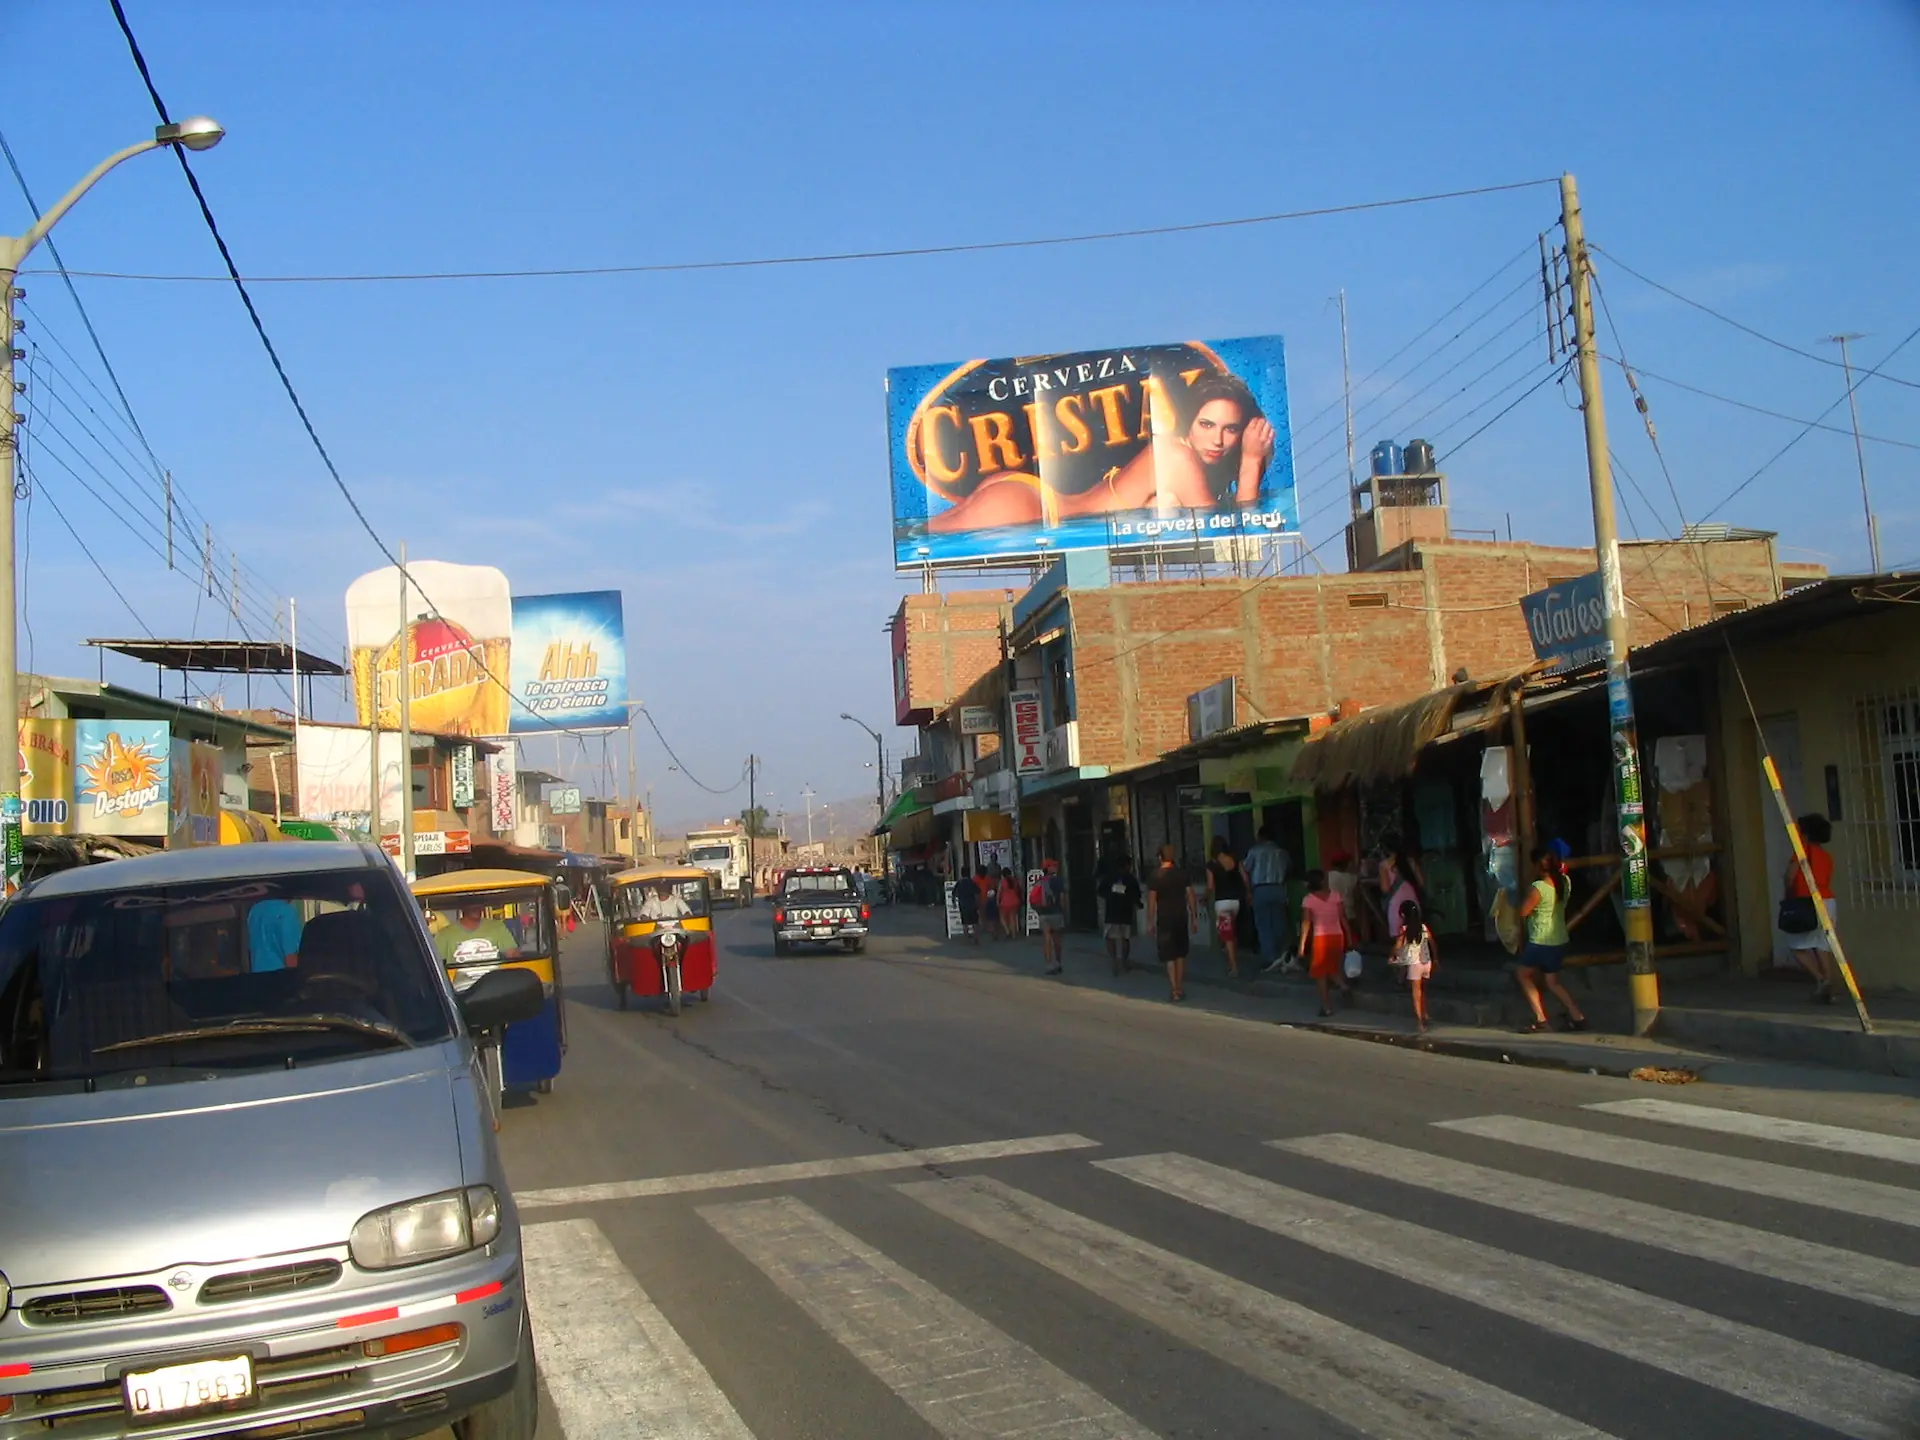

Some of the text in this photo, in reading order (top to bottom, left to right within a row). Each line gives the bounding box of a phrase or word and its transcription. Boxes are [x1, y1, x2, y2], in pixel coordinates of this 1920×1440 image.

[988, 355, 1136, 401] CERVEZA
[922, 368, 1205, 483] CRISTA
[1112, 521, 1132, 536] La
[1136, 516, 1205, 534] cerveza
[1209, 513, 1235, 529] del
[420, 639, 467, 658] CERVEZA
[539, 639, 598, 681] Ahh
[525, 679, 609, 696] Te refresca
[528, 694, 607, 712] y se siente
[30, 731, 69, 766] BRASA
[1016, 702, 1042, 767] GRECIA
[93, 785, 160, 819] Destapa
[791, 907, 854, 921] TOYOTA
